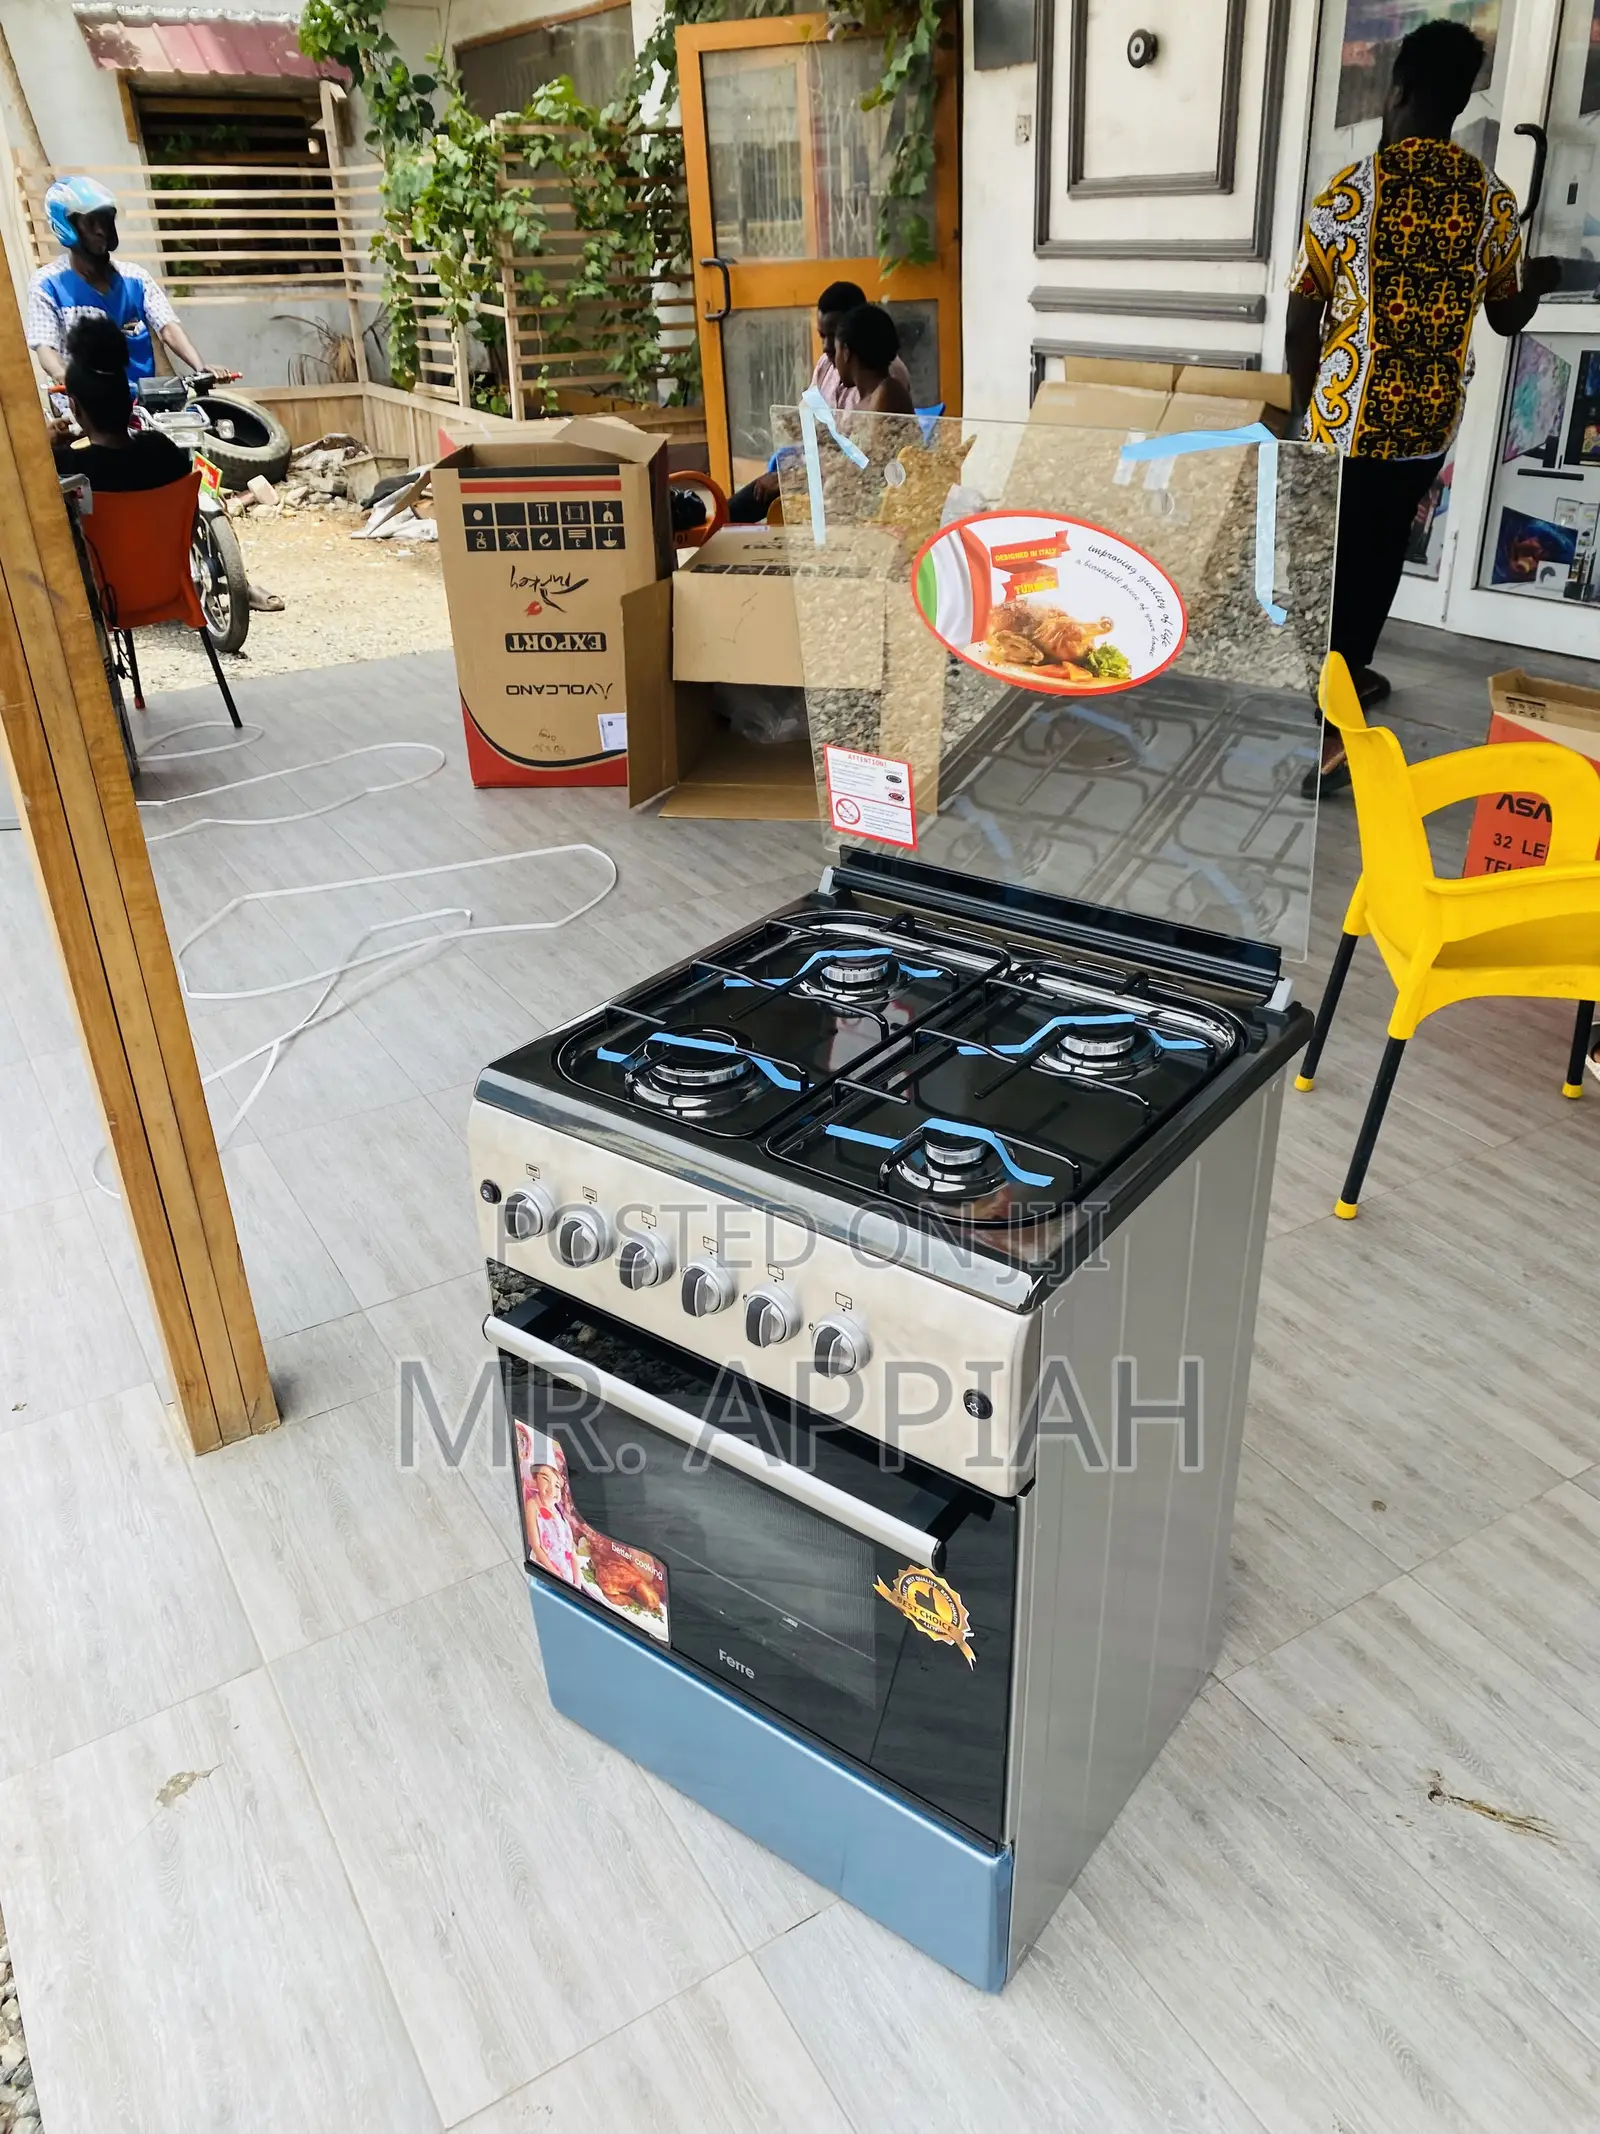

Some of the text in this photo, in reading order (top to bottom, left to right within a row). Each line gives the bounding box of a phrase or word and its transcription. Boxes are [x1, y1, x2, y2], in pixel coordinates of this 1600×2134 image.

[994, 550, 1029, 562] DESIGNED
[1038, 547, 1057, 556] ITALY
[510, 565, 589, 595] Turkey
[1088, 544, 1174, 647] improving quality of life
[1120, 583, 1140, 601] piece
[1139, 602, 1149, 611] of
[509, 634, 603, 651] EXPORT
[505, 684, 598, 696] VOLCANO
[847, 753, 888, 767] ATTENTION!
[1493, 832, 1513, 850] 32
[611, 1541, 663, 1581] better cooking
[915, 1576, 938, 1587] QUALITY
[940, 1588, 953, 1604] BEST
[897, 1596, 952, 1632] BEST CHOICE
[718, 1648, 755, 1679] Ferre
